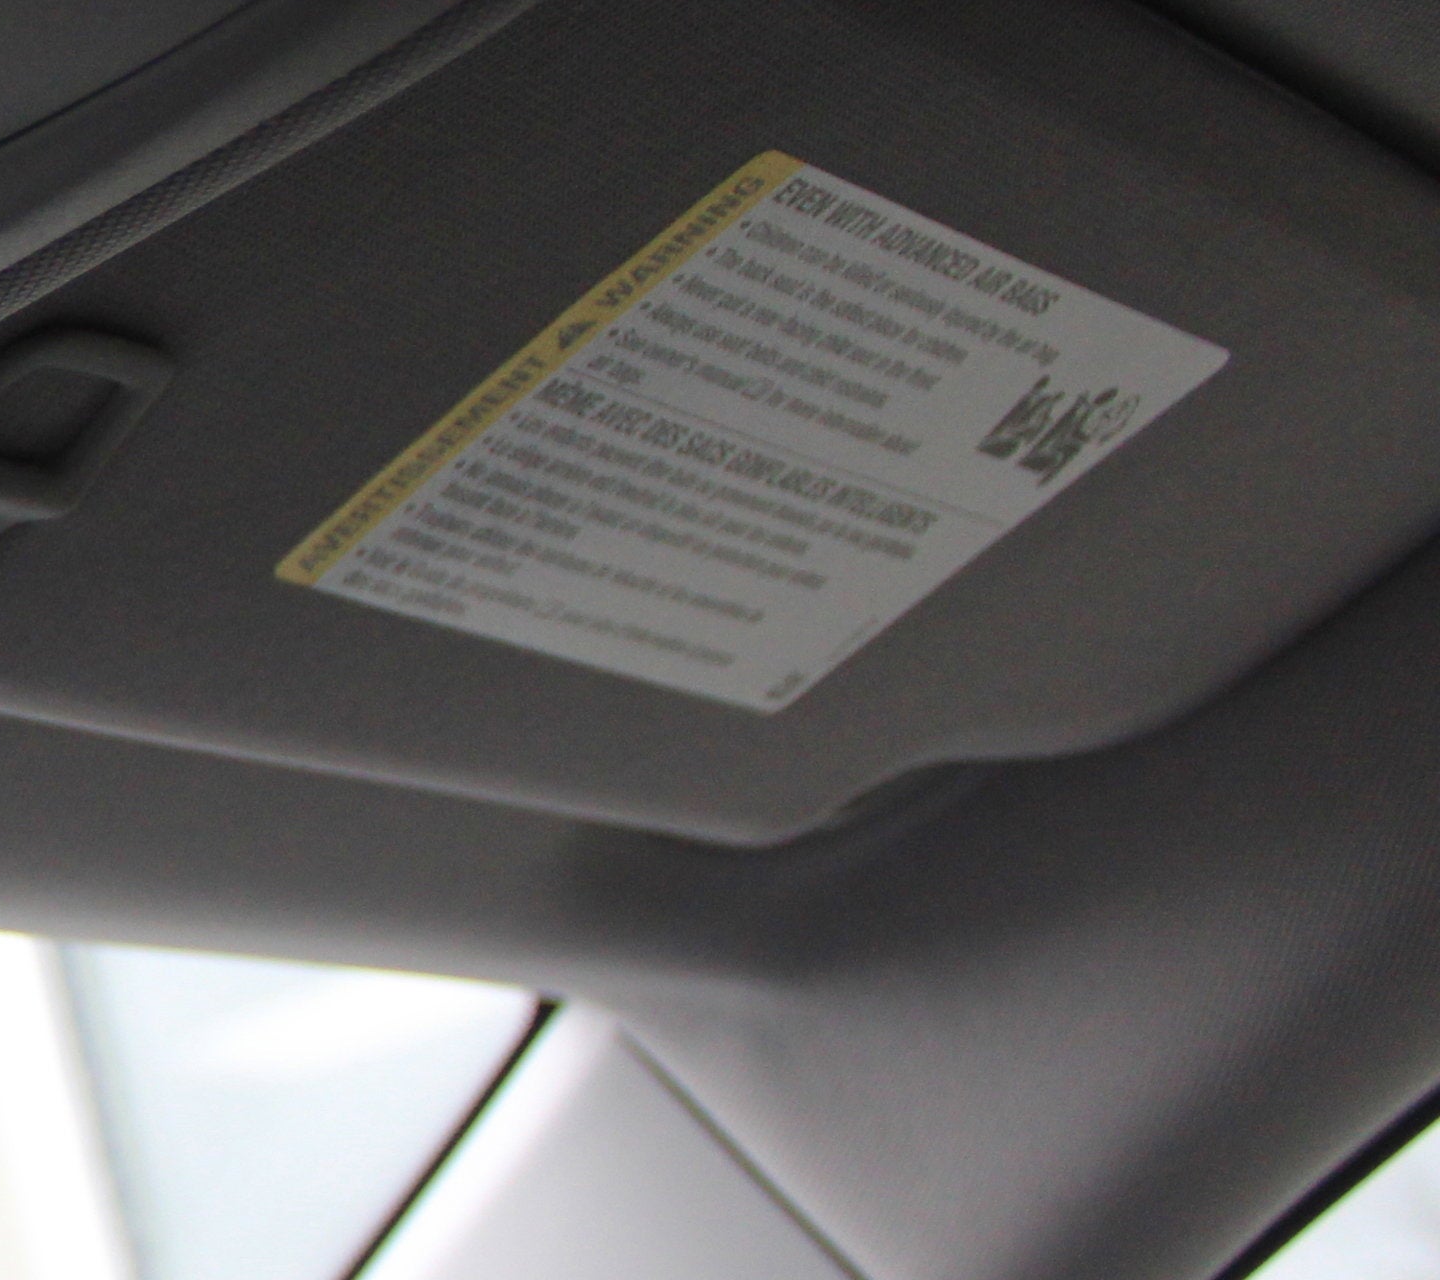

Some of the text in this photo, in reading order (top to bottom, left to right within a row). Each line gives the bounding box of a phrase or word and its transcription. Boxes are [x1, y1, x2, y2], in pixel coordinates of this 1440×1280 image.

[594, 175, 766, 310] WARNING
[772, 177, 1060, 314] EVEN WITH ADVANCED AIR BAGS
